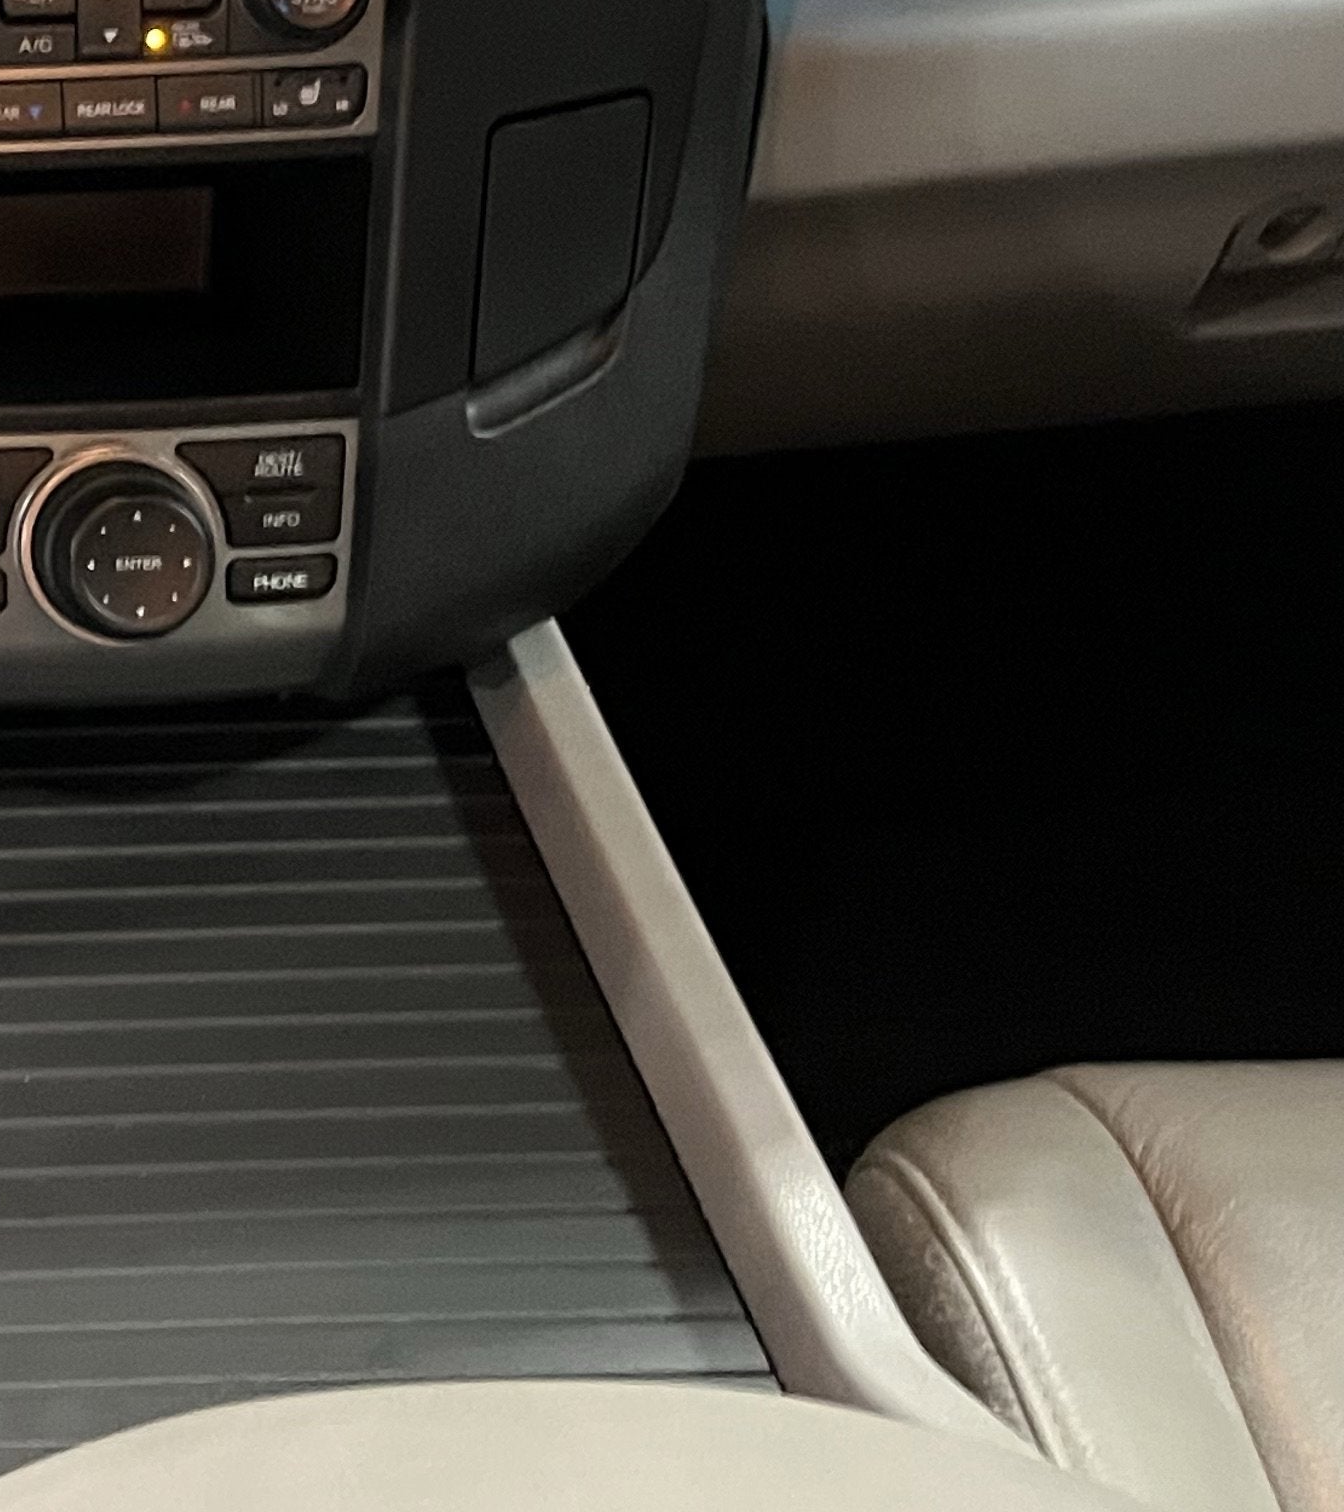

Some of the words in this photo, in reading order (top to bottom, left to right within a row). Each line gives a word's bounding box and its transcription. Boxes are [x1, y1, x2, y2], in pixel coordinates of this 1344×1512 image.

[18, 35, 53, 54] A/C
[263, 511, 301, 528] INFO
[116, 555, 162, 572] ENTER
[253, 571, 307, 591] PHONE
